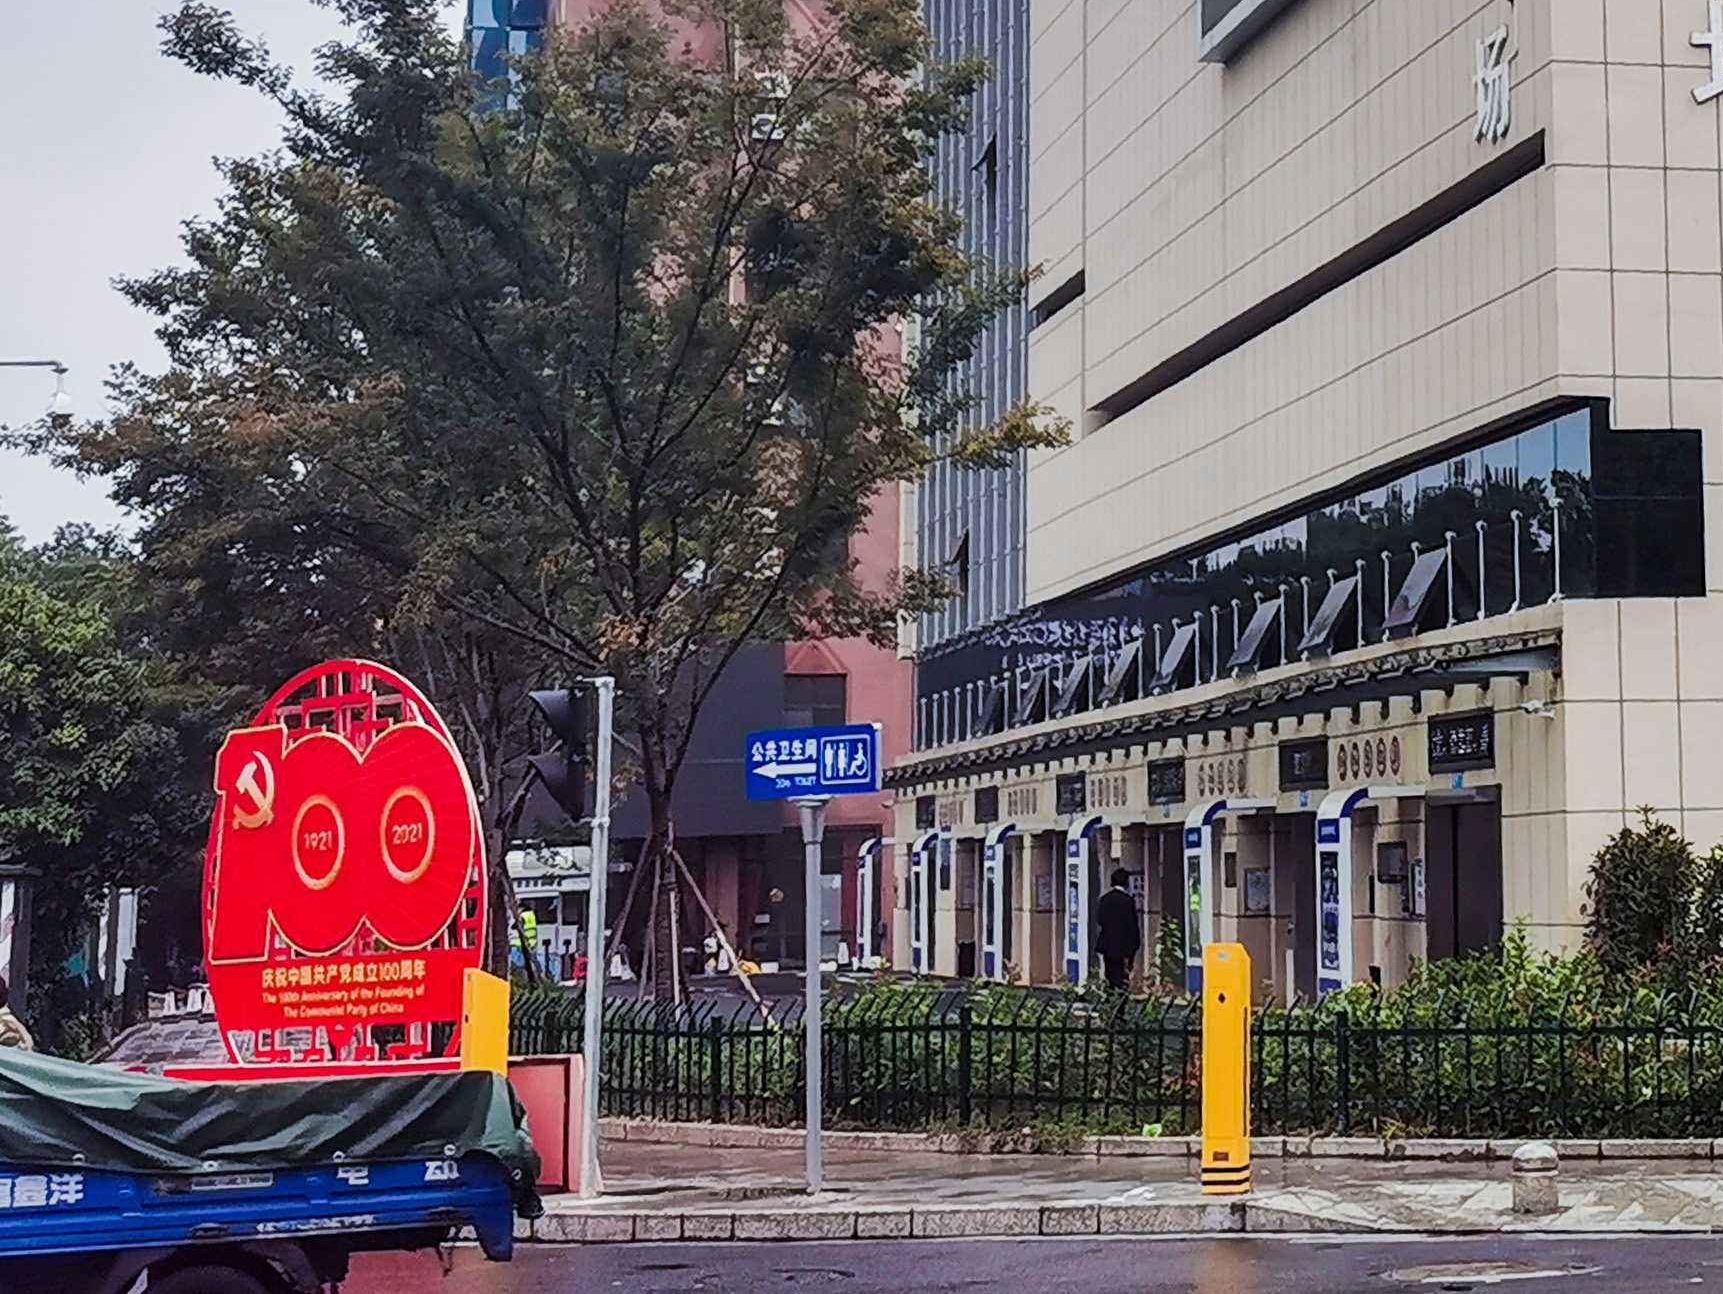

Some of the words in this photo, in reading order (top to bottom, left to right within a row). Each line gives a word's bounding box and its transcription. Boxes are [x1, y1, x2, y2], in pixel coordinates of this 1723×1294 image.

[751, 738, 817, 762] 公共卫生间
[303, 830, 333, 850] 1921
[391, 822, 423, 845] 2021
[261, 958, 427, 989] 庆祝中国共产党成立100周年
